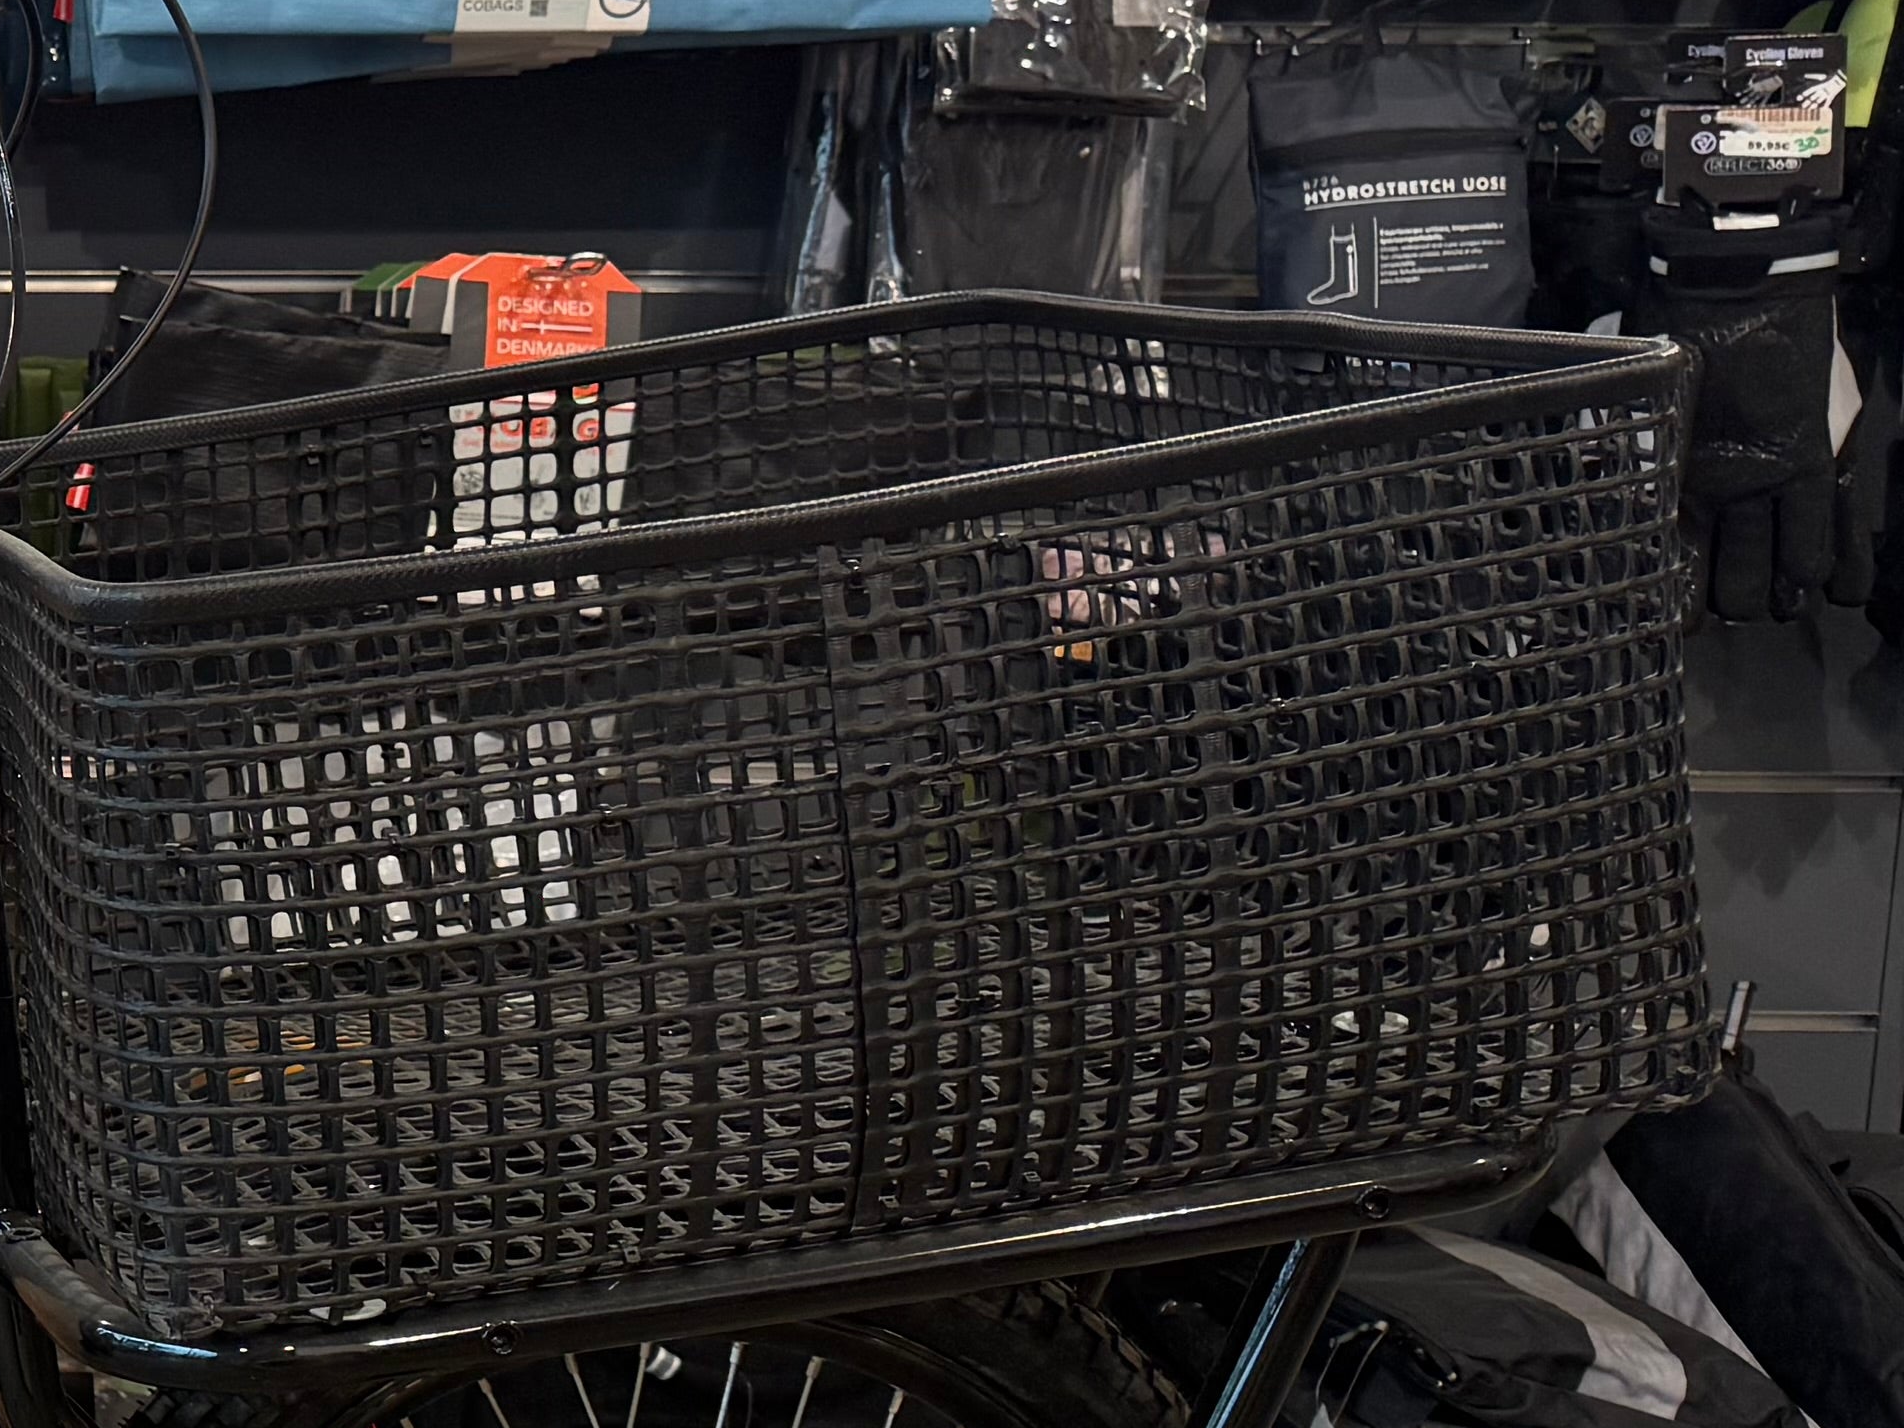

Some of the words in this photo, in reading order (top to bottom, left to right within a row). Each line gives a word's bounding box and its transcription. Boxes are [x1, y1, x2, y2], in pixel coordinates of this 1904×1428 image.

[1304, 178, 1456, 206] HYDROSTRETCH
[498, 295, 594, 317] DESIGNED
[497, 317, 518, 331] IN
